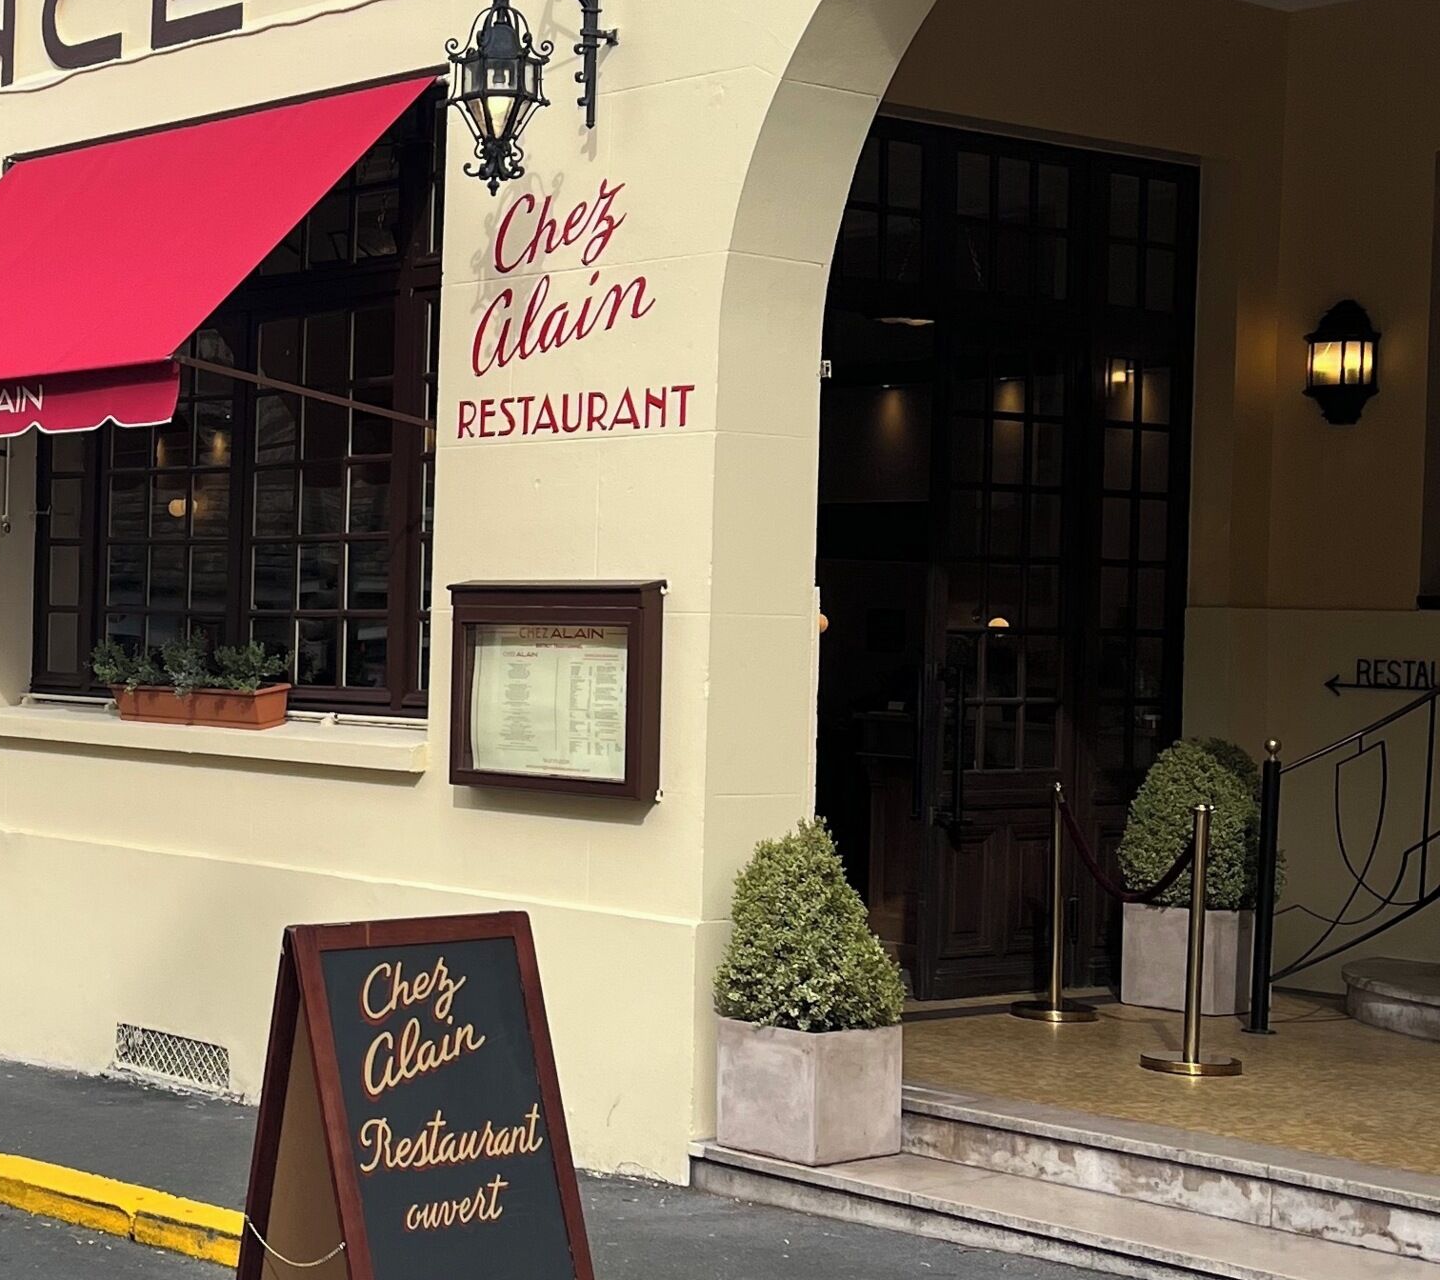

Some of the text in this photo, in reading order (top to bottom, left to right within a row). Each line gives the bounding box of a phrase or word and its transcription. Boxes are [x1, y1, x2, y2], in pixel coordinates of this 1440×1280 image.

[494, 178, 628, 274] Chez
[471, 270, 657, 378] Alain
[457, 384, 696, 439] RESTAURANT
[518, 627, 605, 640] CHEZ ALAIN
[362, 956, 467, 1020] Chez
[363, 1014, 487, 1096] Alain
[360, 1102, 544, 1172] Restaurant
[406, 1173, 510, 1231] ouvert
